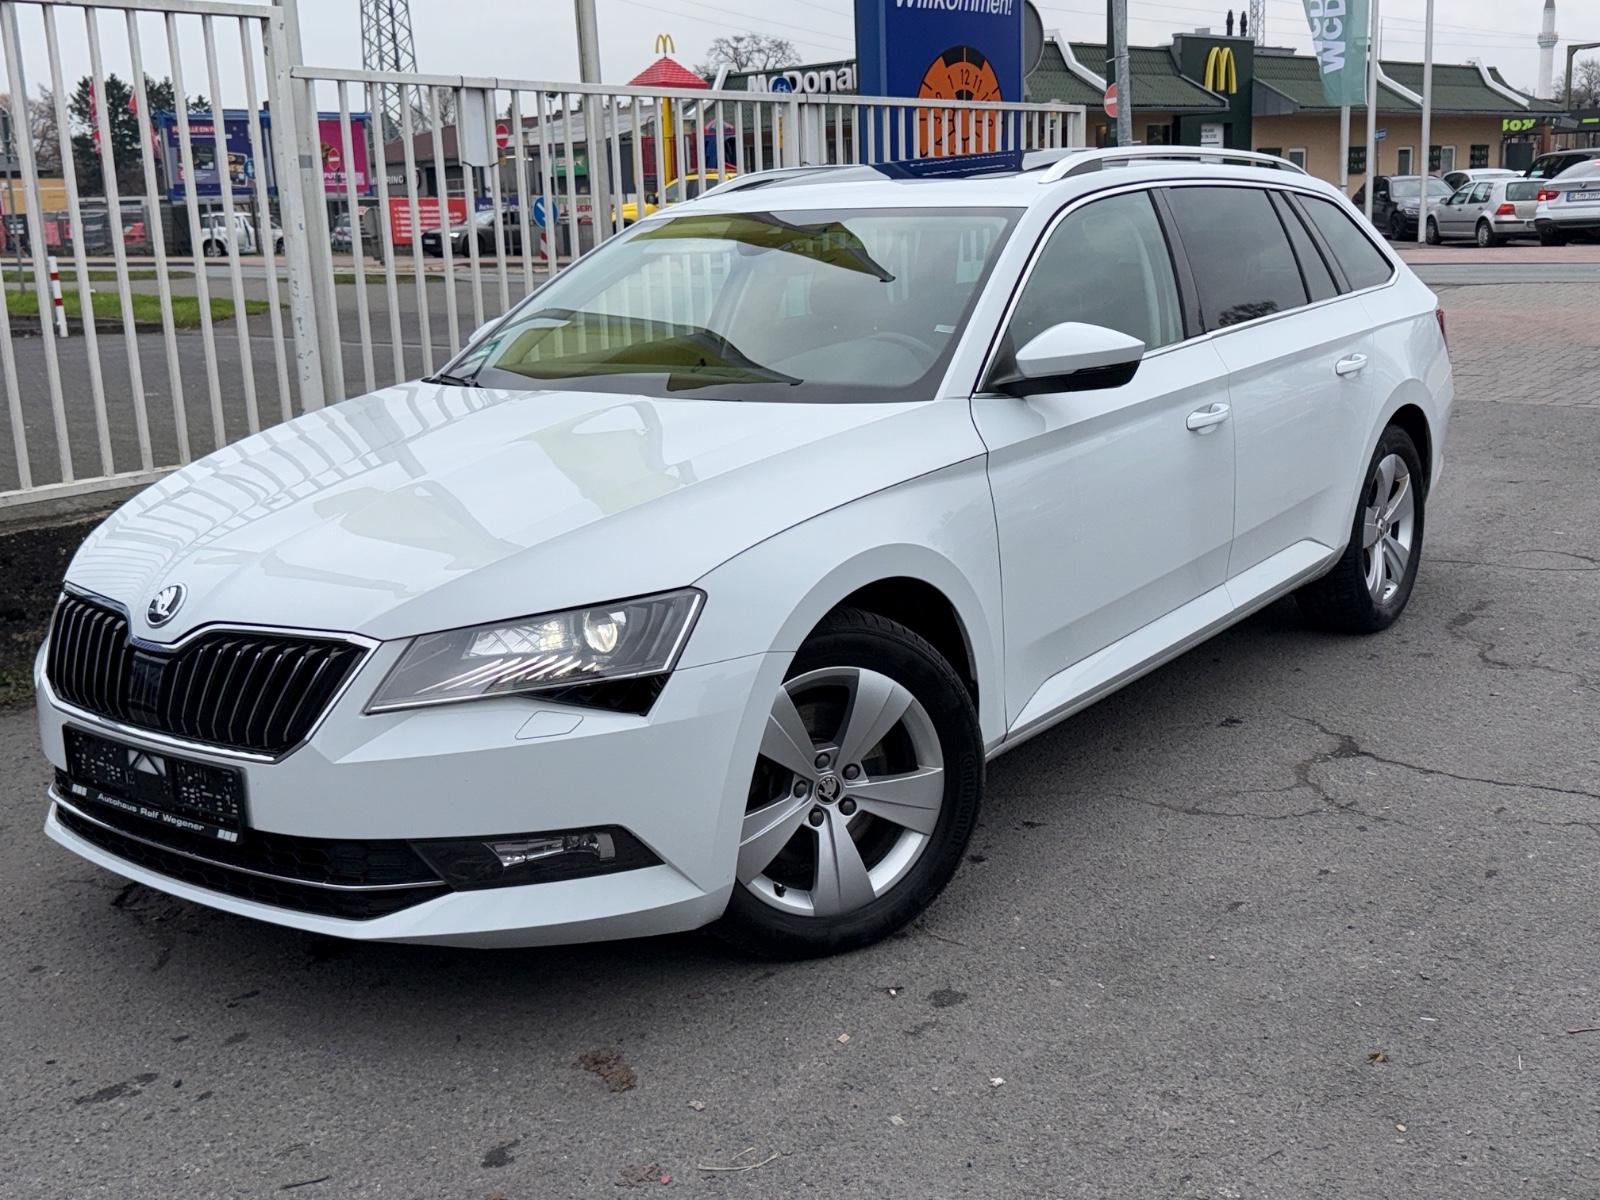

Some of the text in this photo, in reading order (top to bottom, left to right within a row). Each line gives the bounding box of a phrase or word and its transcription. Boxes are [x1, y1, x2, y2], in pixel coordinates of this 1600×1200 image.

[960, 69, 970, 86] 12
[973, 75, 983, 93] 11
[96, 792, 205, 832] Autohaus Ralf Wegener
